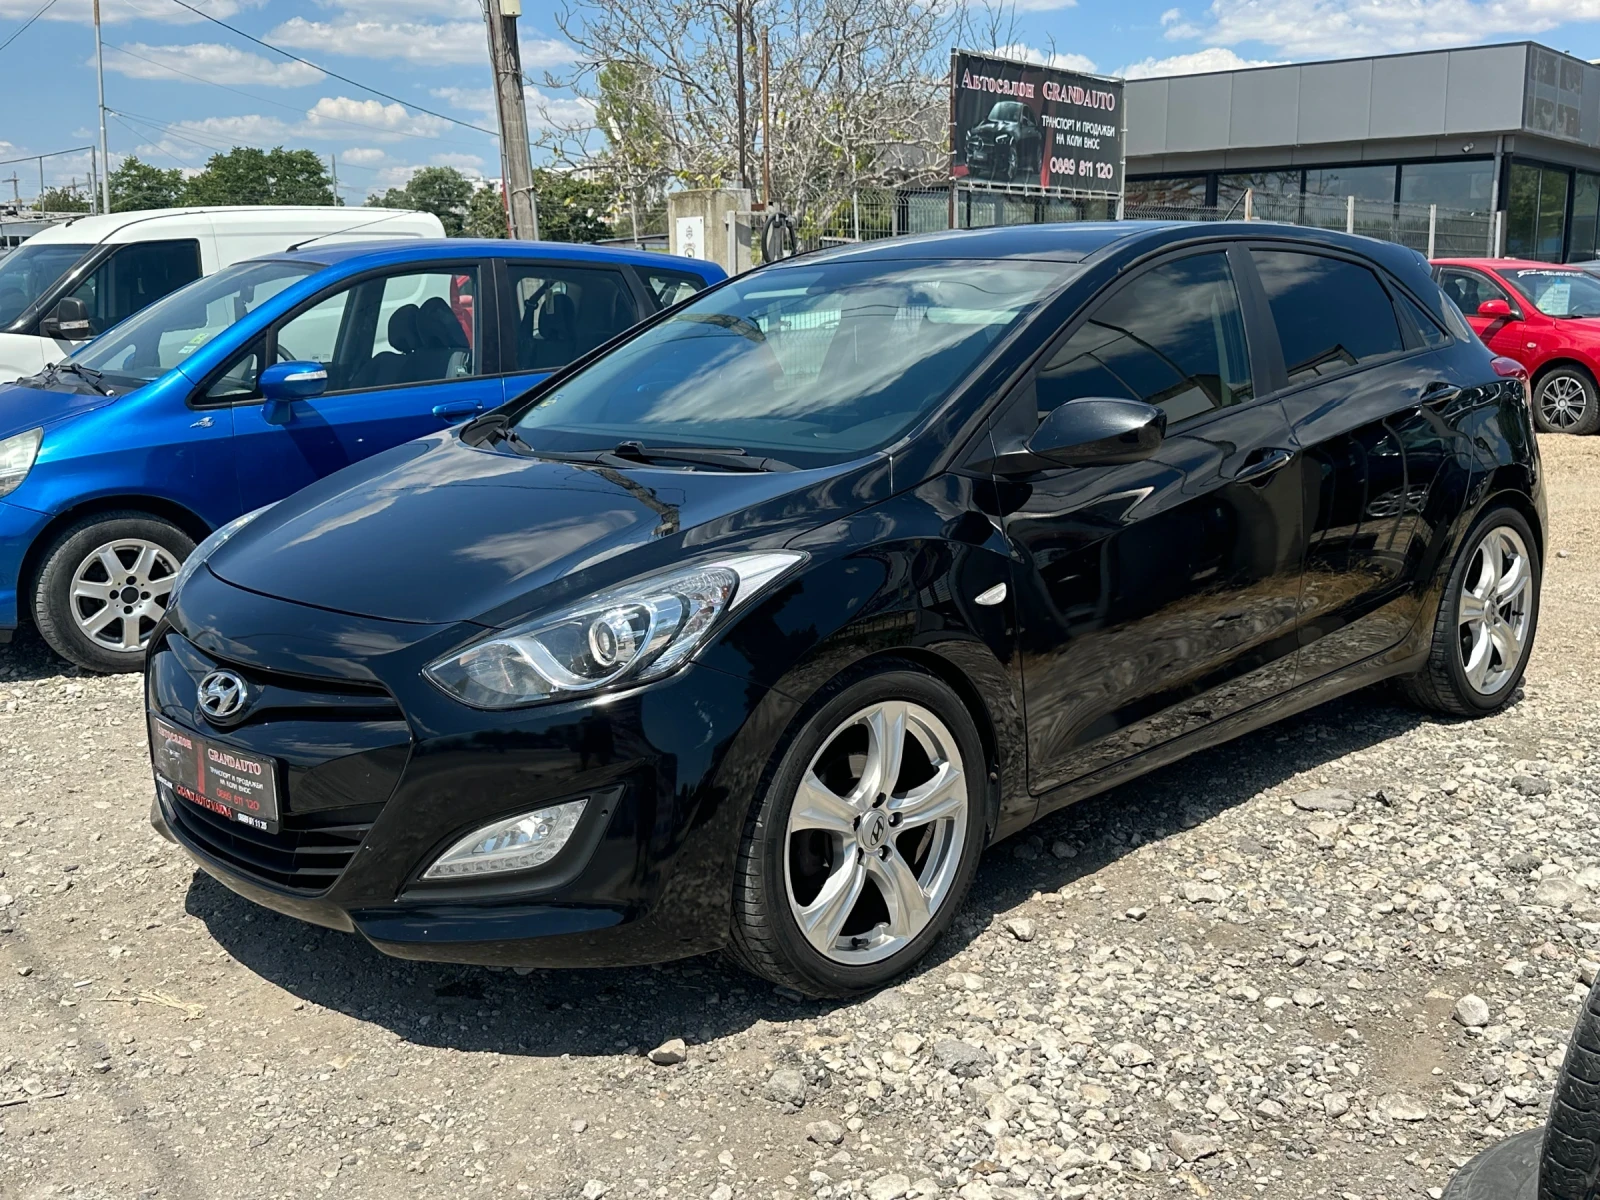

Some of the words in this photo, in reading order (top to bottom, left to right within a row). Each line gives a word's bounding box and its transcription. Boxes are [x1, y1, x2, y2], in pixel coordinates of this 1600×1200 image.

[961, 67, 1035, 98] Автосалон
[1042, 81, 1116, 111] GRANDAUTO
[1041, 115, 1075, 131] ТРАНСПОРТ
[1075, 120, 1081, 132] И
[1082, 121, 1116, 137] ПРОДАЖБИ
[1056, 133, 1065, 145] НА
[1083, 136, 1100, 150] ВНОС
[1049, 156, 1076, 175] 0889
[1078, 160, 1093, 178] 811
[1095, 162, 1114, 179] 120
[207, 748, 262, 776] GRANDAUTO
[246, 798, 260, 811] 120
